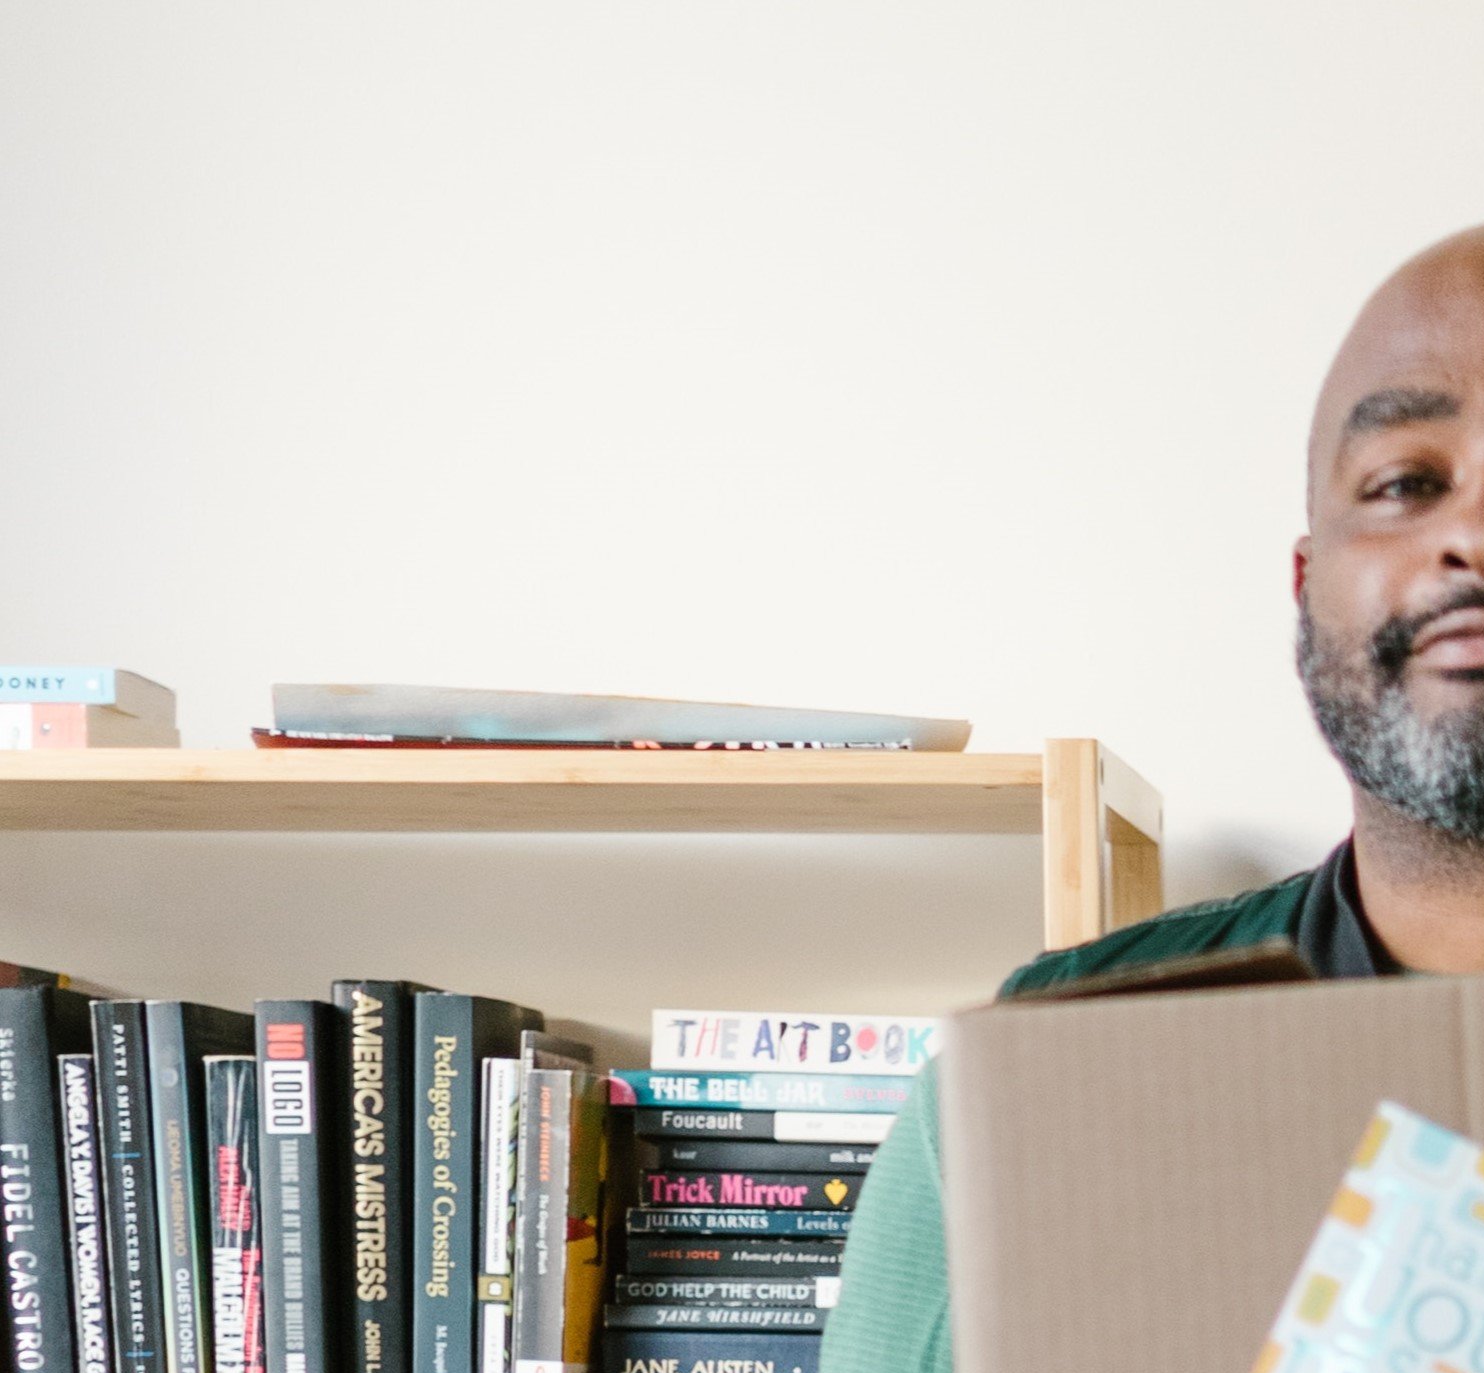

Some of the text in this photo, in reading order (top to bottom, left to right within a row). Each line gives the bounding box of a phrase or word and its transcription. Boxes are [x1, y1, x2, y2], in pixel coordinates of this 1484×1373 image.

[112, 1023, 129, 1077] PATTI
[266, 1023, 305, 1060] NO
[667, 1017, 934, 1065] THE ART BOOK
[271, 1069, 305, 1127] LOGO
[352, 990, 388, 1157] AMERICA'S
[426, 1035, 459, 1160] Pedagogies
[650, 1076, 699, 1101] THE
[706, 1077, 768, 1102] BELL
[776, 1080, 827, 1105] JAR
[64, 1061, 90, 1144] ANGELA
[116, 1085, 133, 1143] SMITH
[661, 1110, 743, 1130] Foucault
[72, 1160, 96, 1215] DAVIS
[433, 1165, 458, 1193] of
[648, 1173, 808, 1206] Trick Mirror
[121, 1165, 140, 1272] COLLECTED
[282, 1213, 302, 1230] AT
[353, 1163, 388, 1302] MISTRESS
[645, 1214, 701, 1230] JULIAN
[706, 1214, 769, 1230] BARNES
[796, 1216, 840, 1231] Levels
[0, 1142, 45, 1371] FIDEL CASTRO
[77, 1225, 101, 1307] WOMEN,
[424, 1195, 457, 1298] Crossing
[128, 1279, 145, 1343] LYRICS
[174, 1268, 198, 1364] QUESTIONS
[213, 1247, 245, 1362] MALCOLM
[628, 1283, 810, 1300] GOD HELP THE CHILD
[656, 1309, 816, 1327] JANE HIRSHFIELD
[81, 1307, 105, 1362] RACE
[364, 1320, 383, 1360] JOHN
